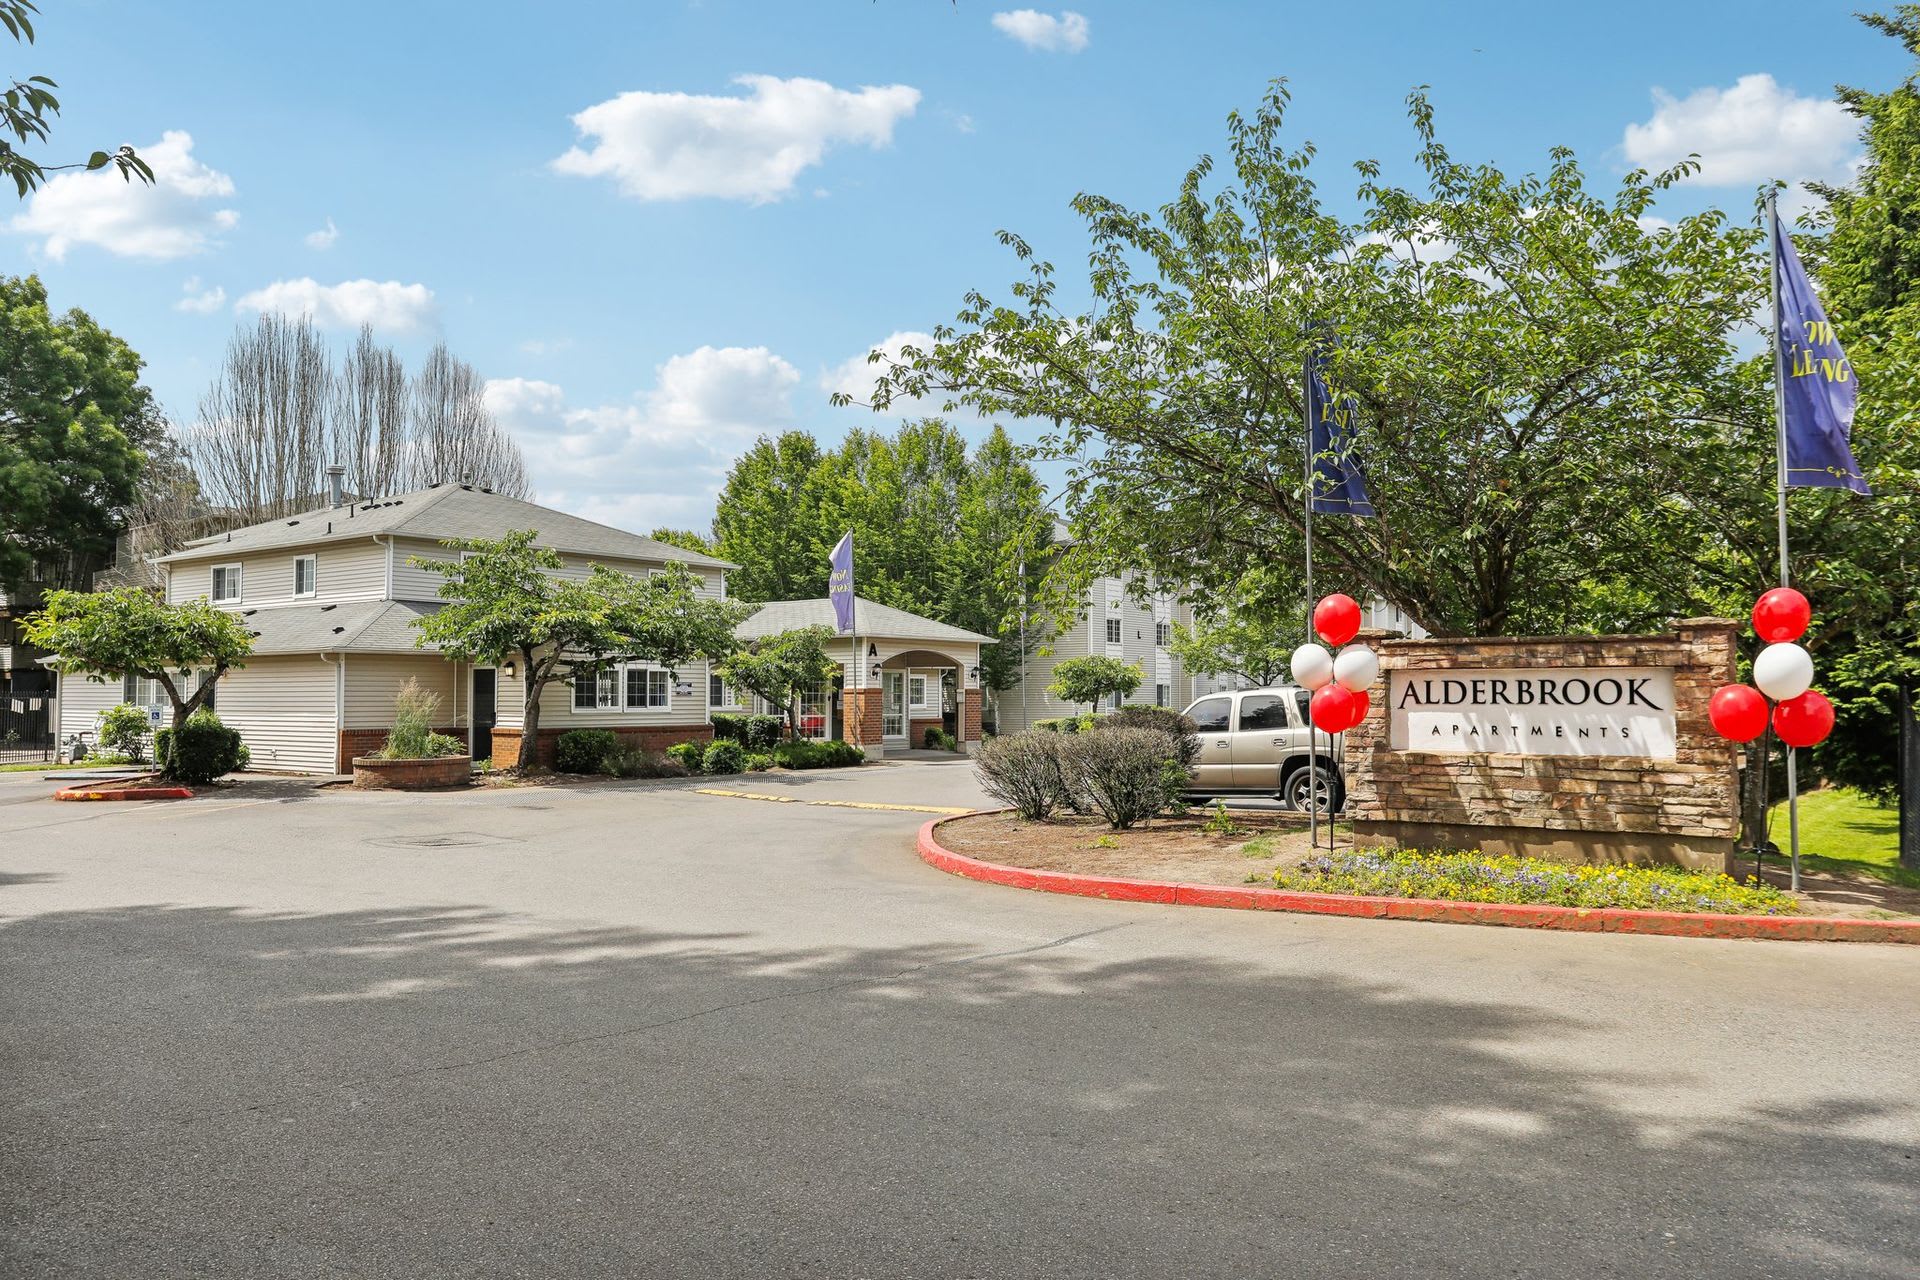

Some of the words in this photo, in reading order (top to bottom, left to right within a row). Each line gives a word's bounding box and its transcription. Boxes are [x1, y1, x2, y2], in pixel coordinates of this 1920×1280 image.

[868, 642, 878, 657] A
[1398, 678, 1664, 711] ALDERBROOK
[1431, 724, 1631, 739] APARTMENTS
